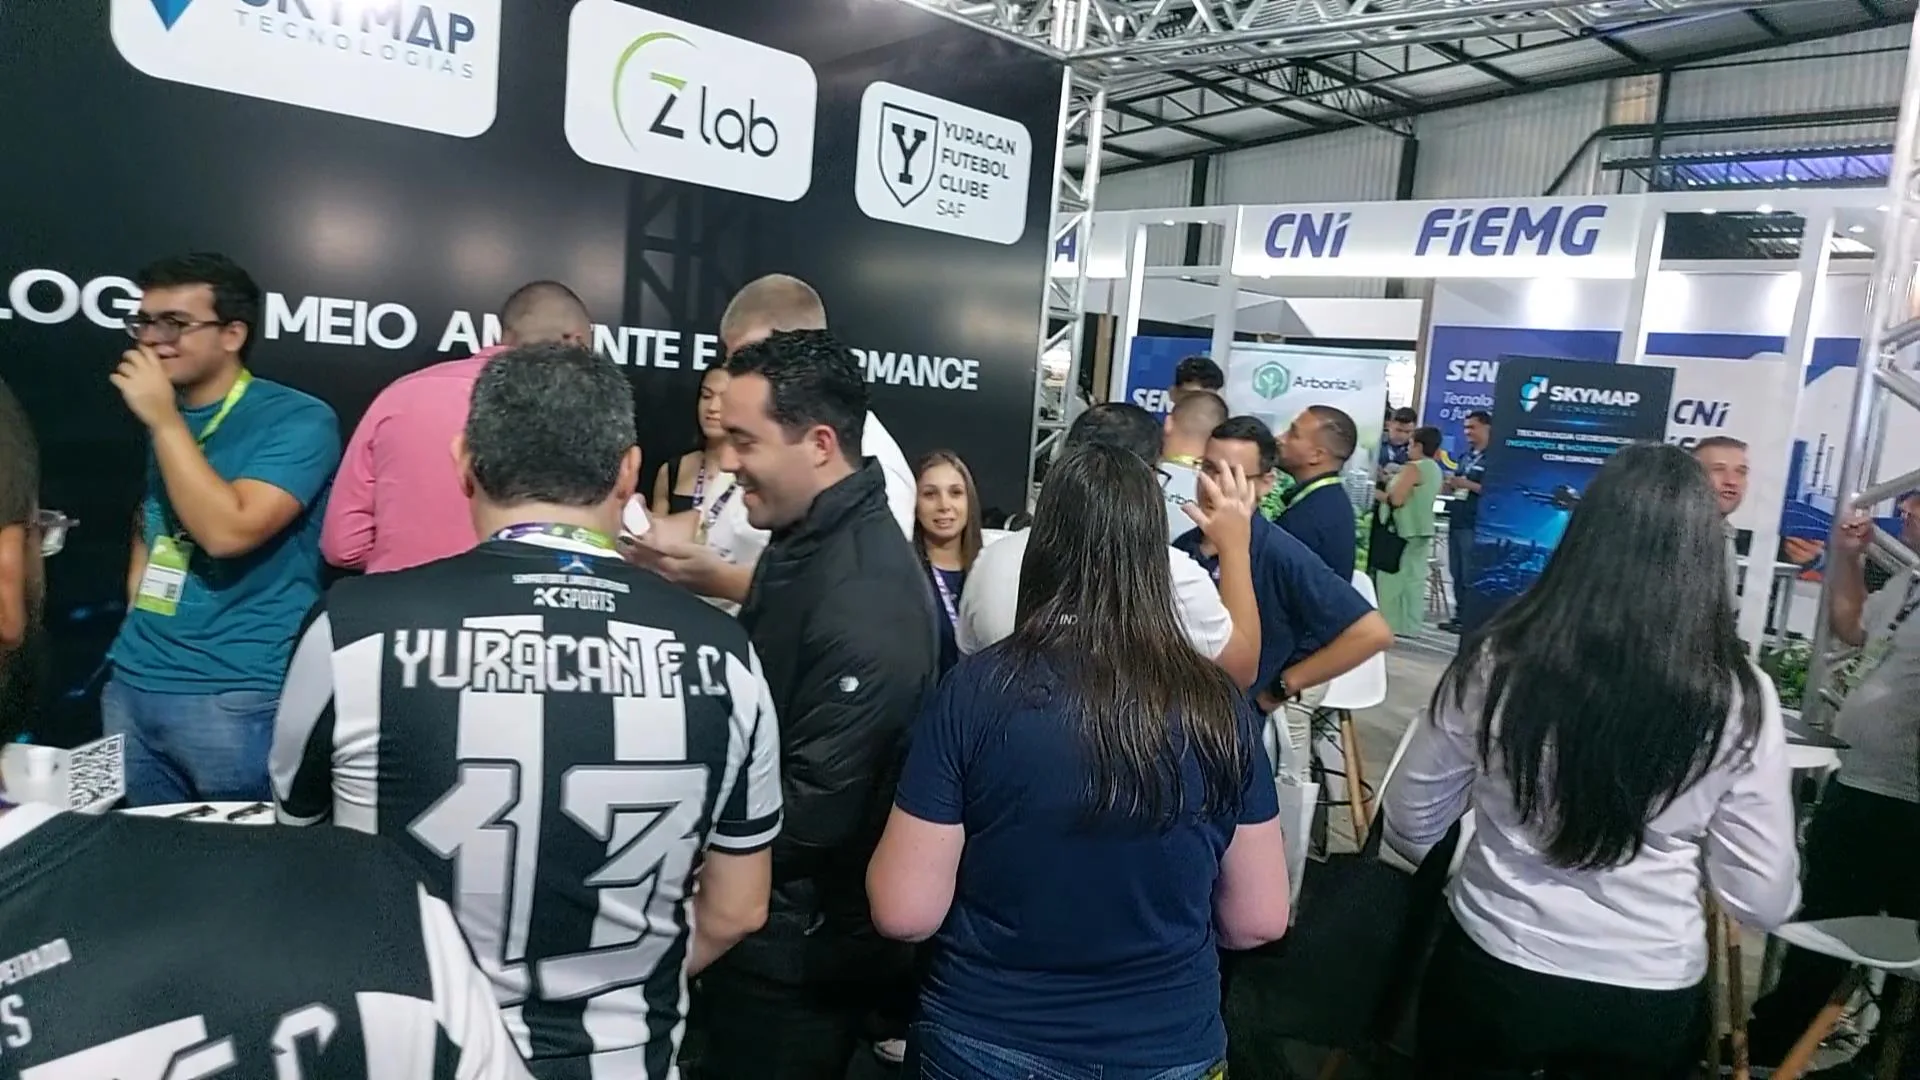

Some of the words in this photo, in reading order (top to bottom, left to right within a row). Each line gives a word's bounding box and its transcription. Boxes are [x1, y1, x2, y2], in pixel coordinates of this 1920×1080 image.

[234, 9, 474, 79] TECNOLOGIAS
[944, 121, 1017, 155] YURACAN
[941, 148, 1010, 180] FUTEBOL
[939, 174, 990, 199] CLUBE
[936, 199, 967, 219] SAF
[264, 293, 418, 350] MEIO
[1446, 359, 1500, 383] SEN
[1549, 385, 1641, 408] SKYMAP
[394, 628, 645, 698] YURACAN
[406, 759, 711, 1004] 13
